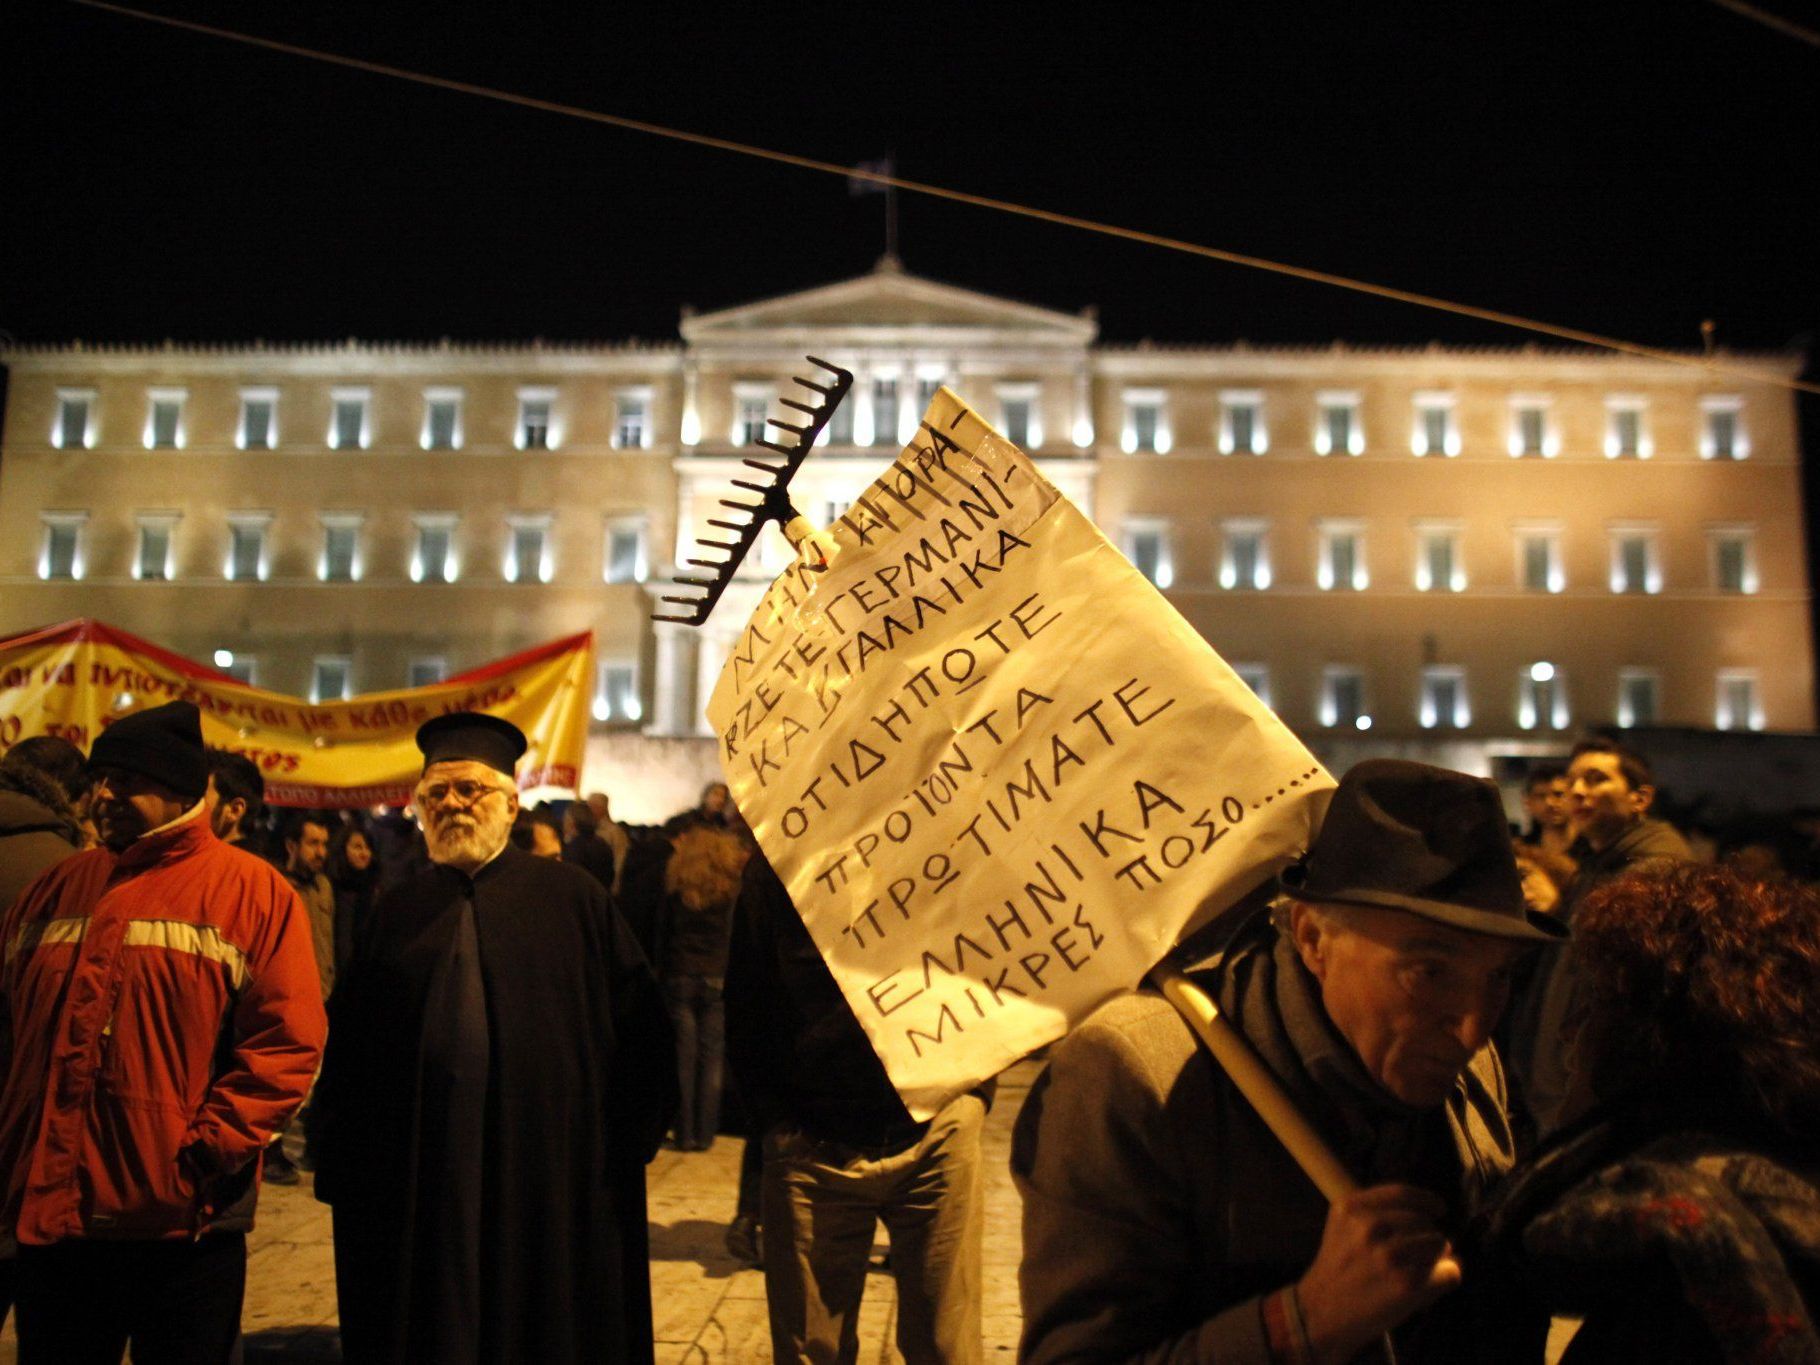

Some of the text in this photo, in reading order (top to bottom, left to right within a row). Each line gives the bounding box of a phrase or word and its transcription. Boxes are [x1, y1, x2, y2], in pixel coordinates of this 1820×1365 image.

[837, 529, 1032, 674] ΓΑΛΛΙΚΑ
[866, 780, 1185, 1017] ΕΛΛΗΝΙΚΑ
[906, 904, 1104, 1057] ΜΙΚΡΕΣ
